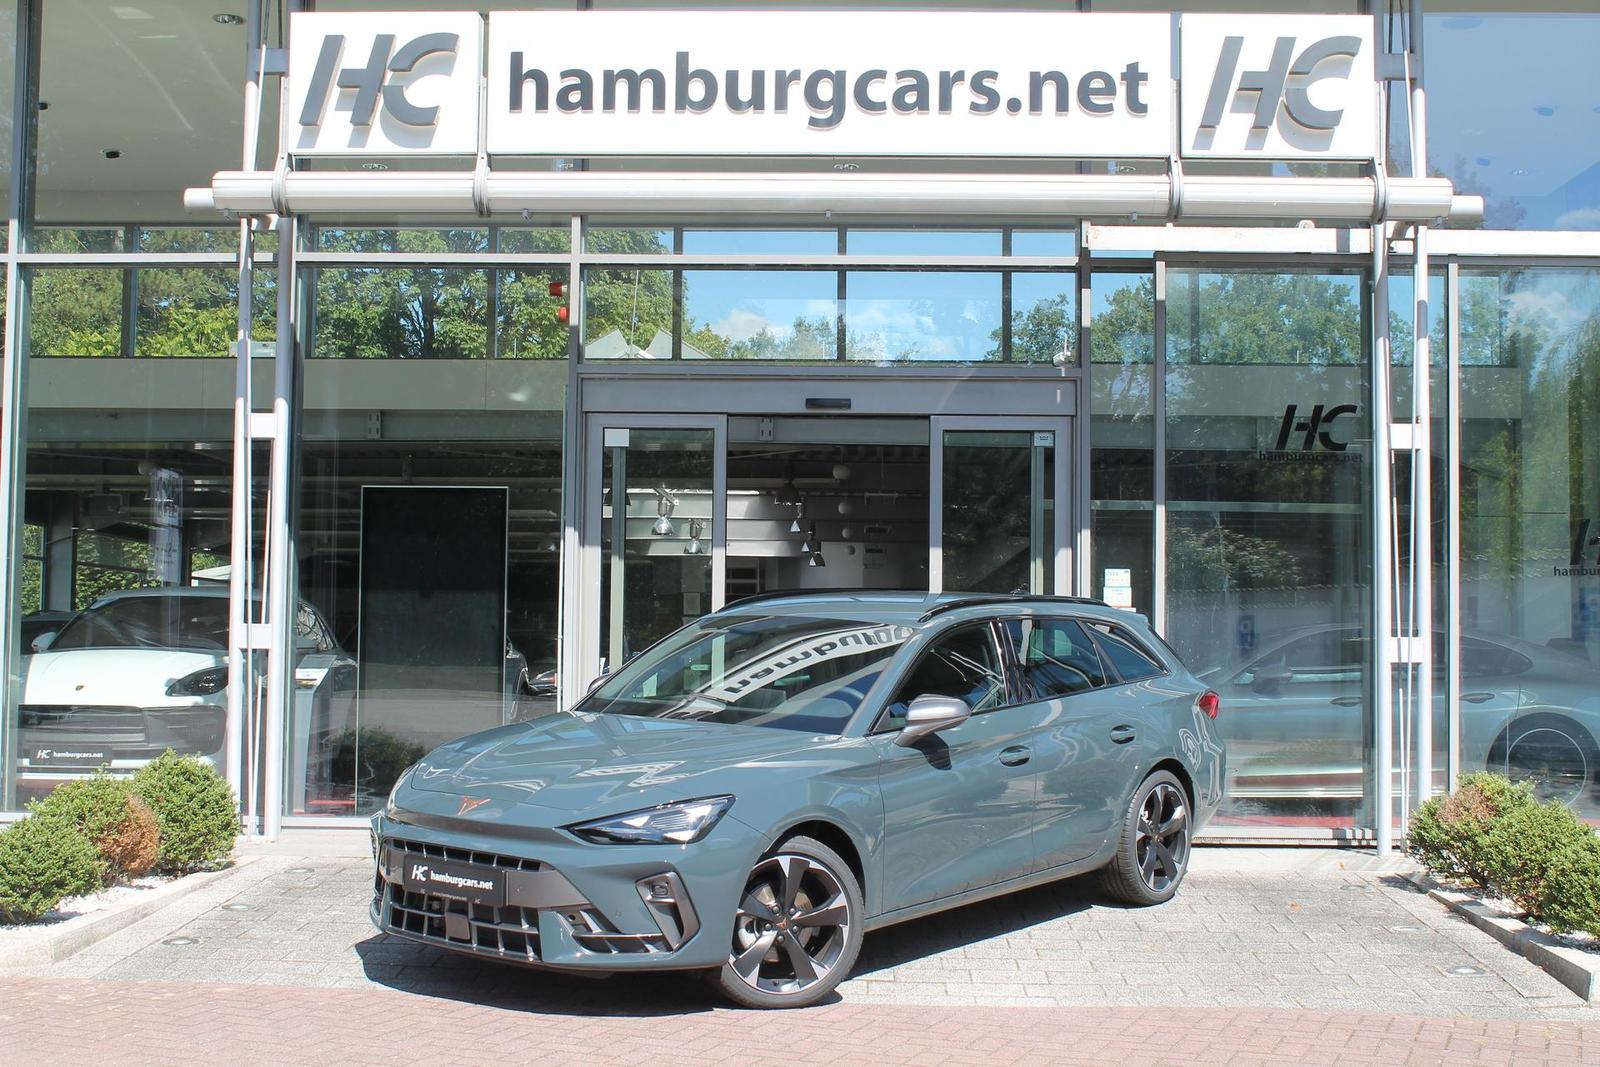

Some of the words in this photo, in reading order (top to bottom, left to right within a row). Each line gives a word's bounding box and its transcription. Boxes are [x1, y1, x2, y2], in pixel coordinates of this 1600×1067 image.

[299, 32, 461, 127] HC
[509, 51, 1149, 129] hamburgcars.net
[1199, 35, 1363, 131] HC
[1275, 404, 1358, 451] HC
[411, 864, 429, 882] HC
[430, 870, 494, 890] hamburgcars.net
